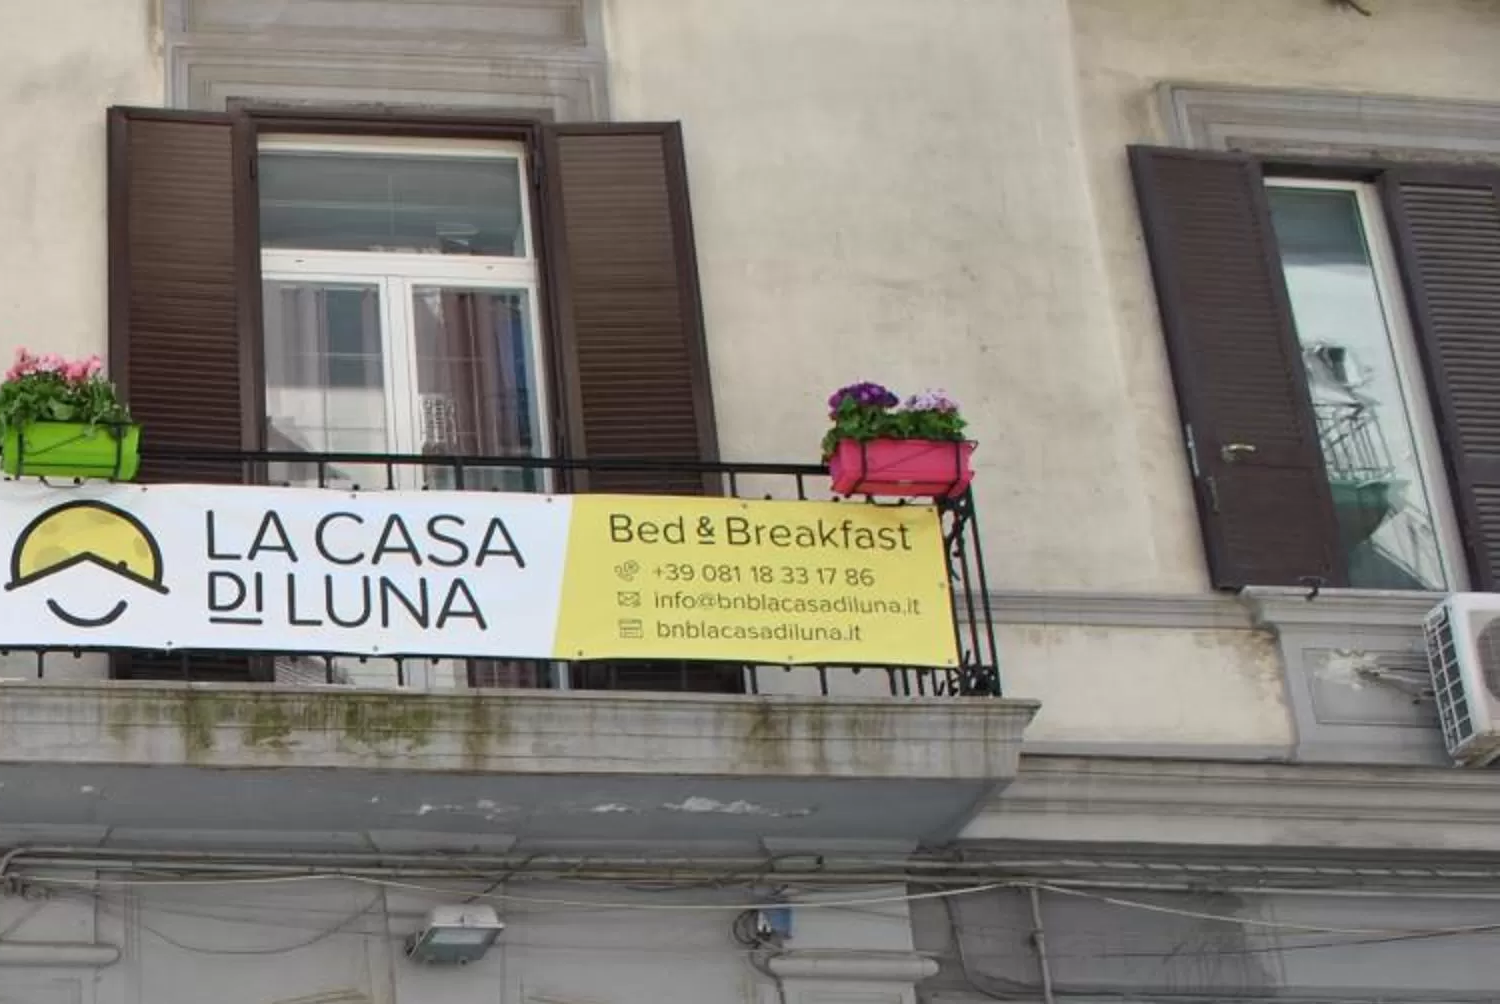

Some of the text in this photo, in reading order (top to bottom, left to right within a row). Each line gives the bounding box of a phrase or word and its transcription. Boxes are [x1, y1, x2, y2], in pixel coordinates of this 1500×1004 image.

[206, 509, 526, 568] LA CASA
[609, 514, 912, 551] Bed & Breakfast
[652, 563, 876, 587] +39 081 18 33 17 86
[207, 571, 488, 630] DI LUNA
[653, 591, 920, 616] info@bnblacasadiluna.it
[656, 619, 862, 642] bnblacasadiluna.it
